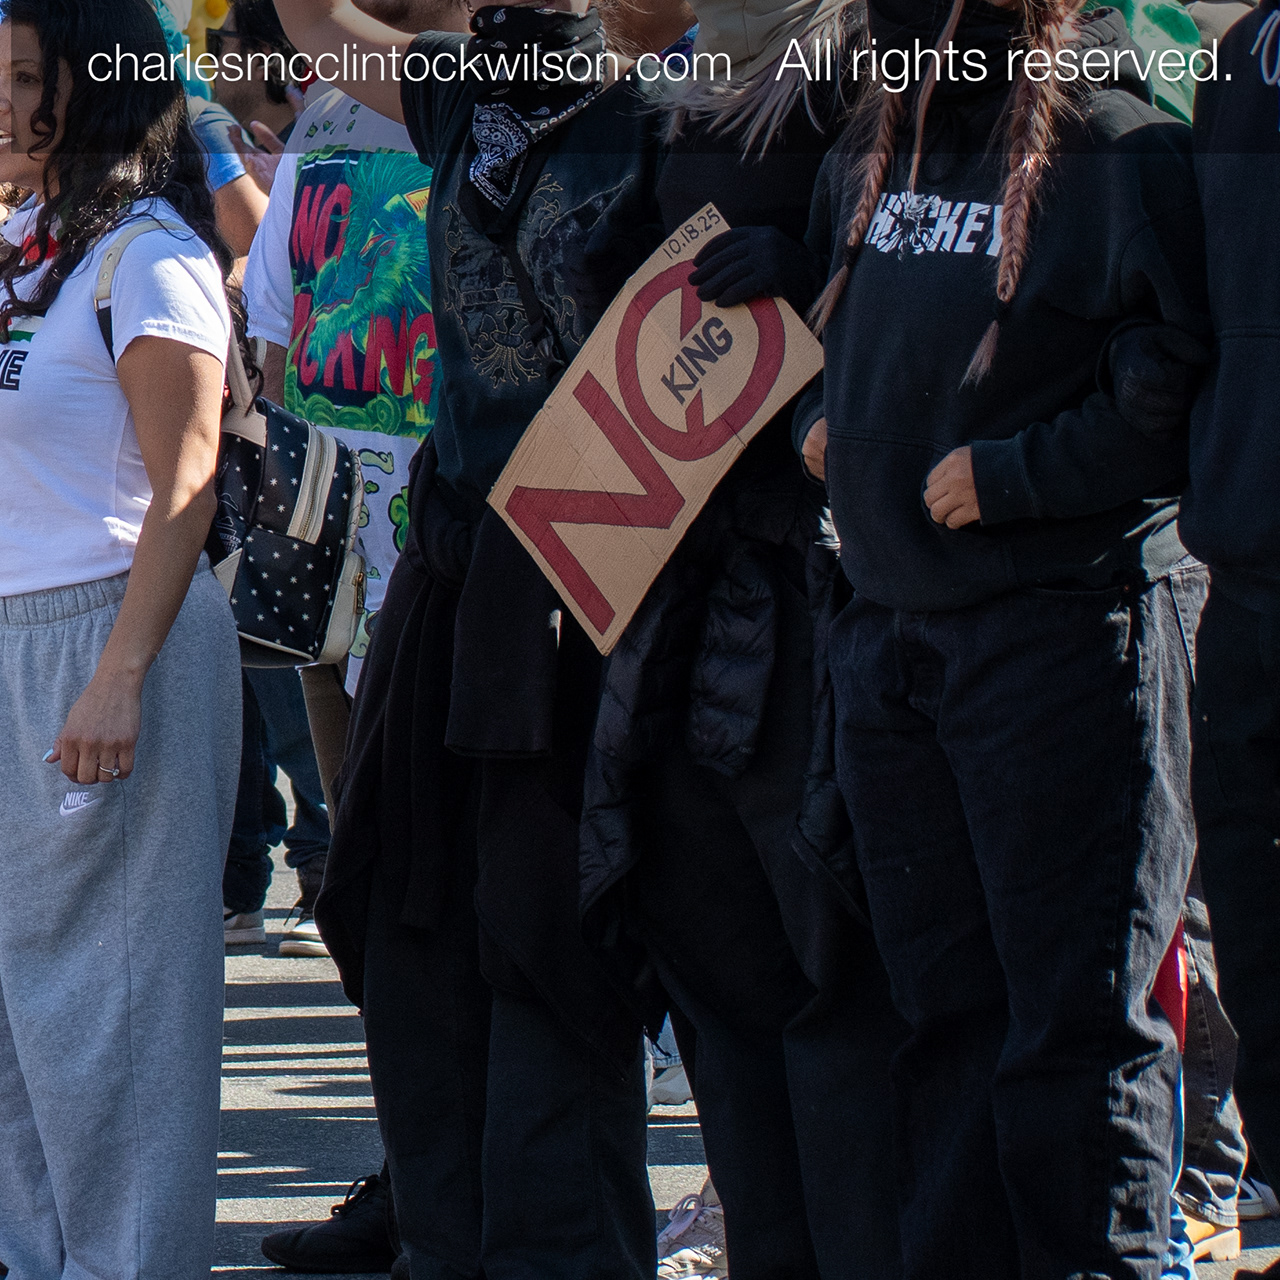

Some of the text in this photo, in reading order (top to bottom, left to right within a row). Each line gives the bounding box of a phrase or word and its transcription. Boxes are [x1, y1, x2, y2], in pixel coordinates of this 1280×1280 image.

[292, 183, 352, 273] NO
[663, 208, 722, 260] 10.18.25
[661, 316, 733, 405] KING
[504, 258, 786, 636] NO
[64, 791, 90, 806] NIKE
